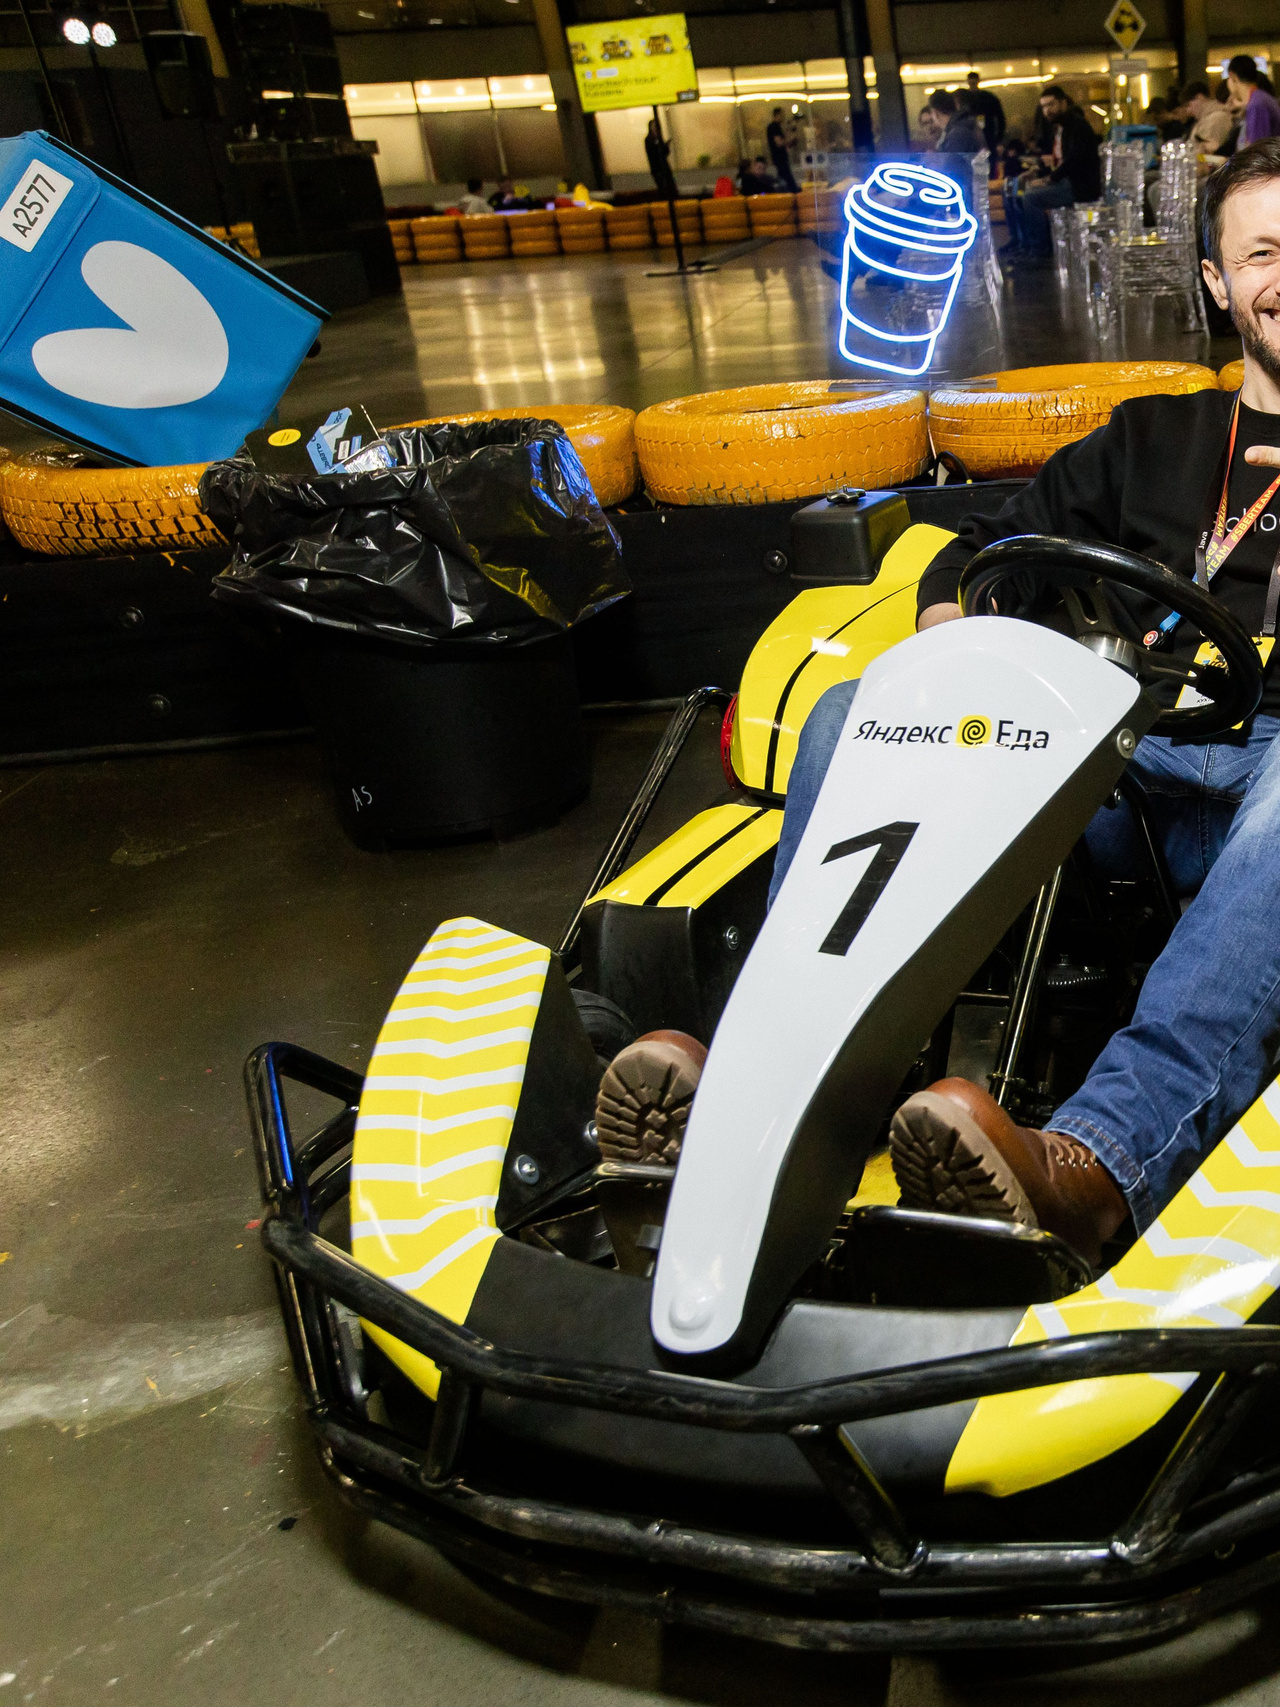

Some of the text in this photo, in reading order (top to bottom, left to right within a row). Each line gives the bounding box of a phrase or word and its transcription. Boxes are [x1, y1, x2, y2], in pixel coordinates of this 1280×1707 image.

[12, 173, 57, 239] A2577
[1198, 531, 1209, 550] Java
[1230, 489, 1274, 543] #SBERTEAM
[853, 719, 1050, 751] Яндекс Еда
[818, 820, 921, 957] 1
